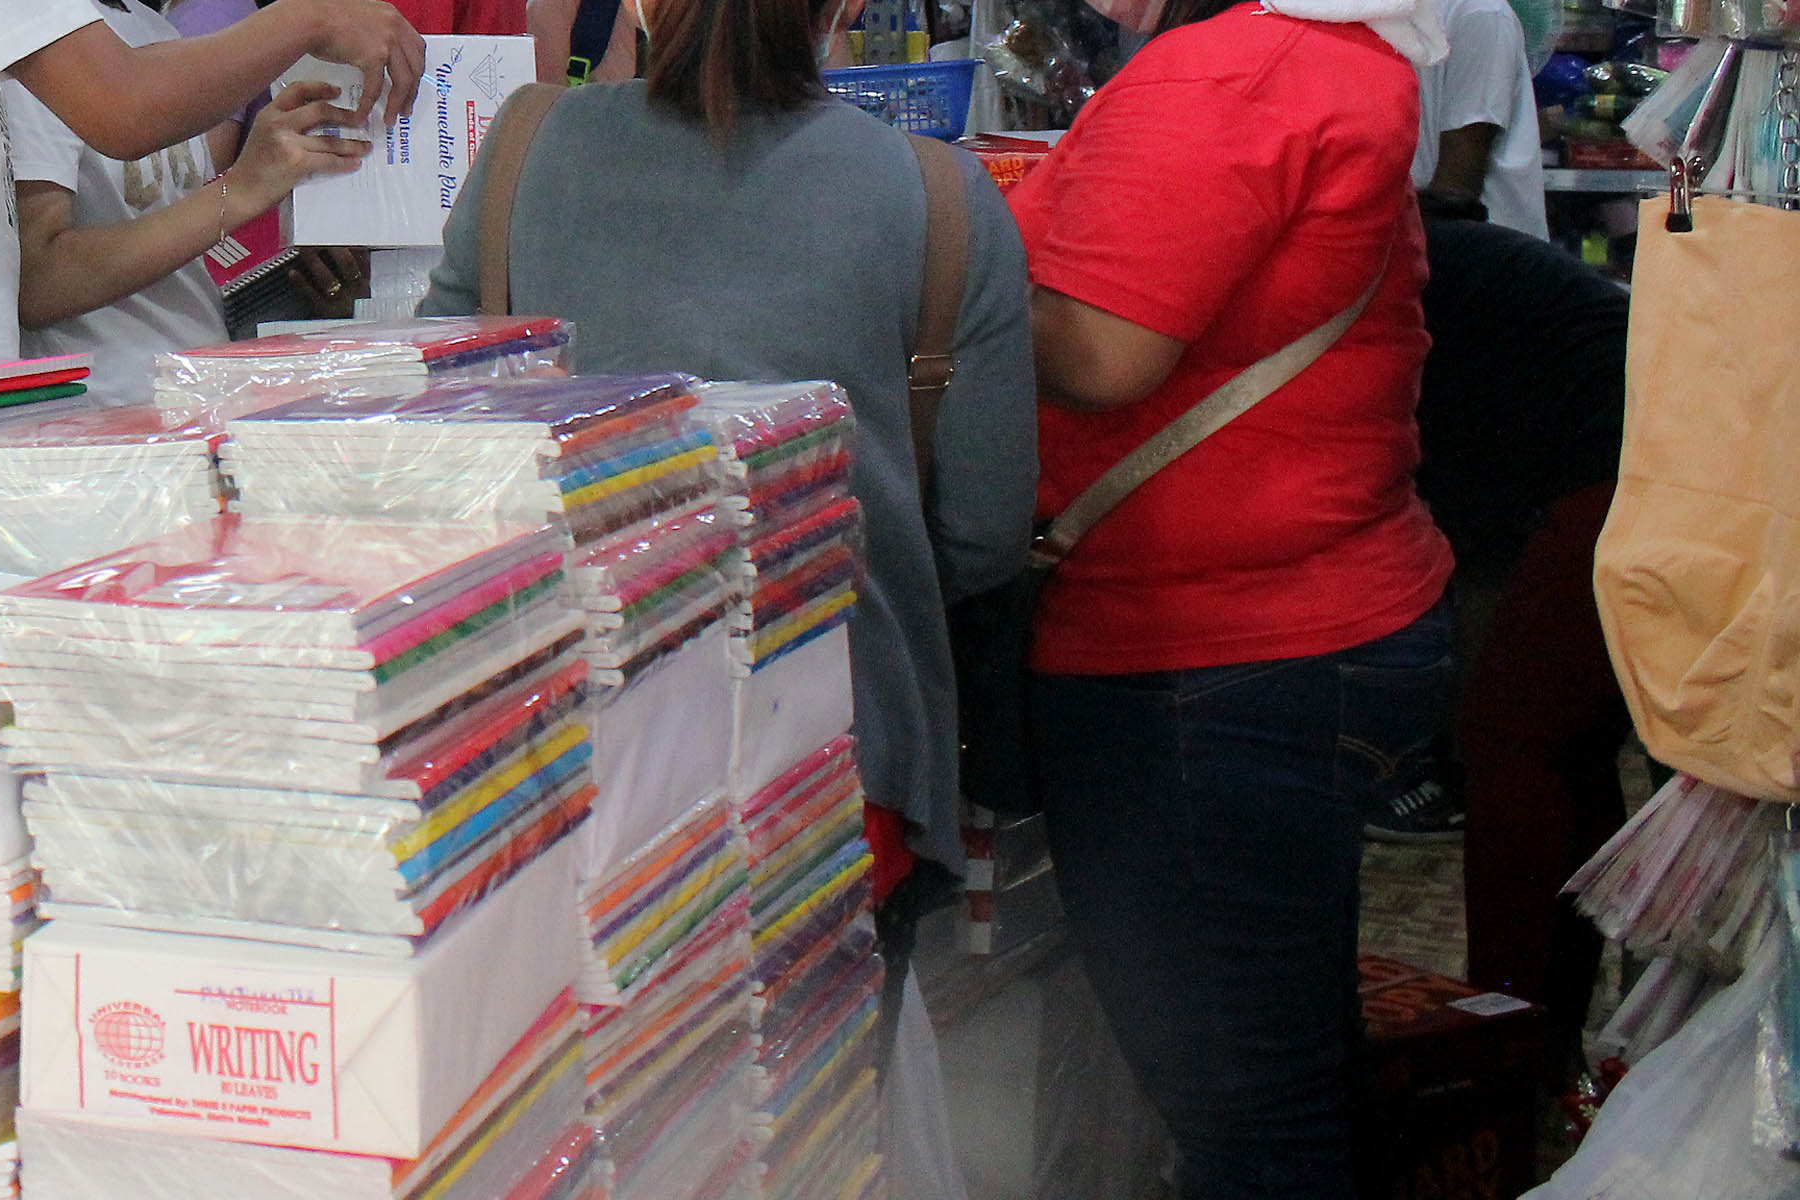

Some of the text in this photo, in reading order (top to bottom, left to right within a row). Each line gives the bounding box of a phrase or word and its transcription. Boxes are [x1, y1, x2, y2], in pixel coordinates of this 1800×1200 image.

[399, 127, 411, 164] Leaves
[435, 63, 458, 209] Intermediate Pad
[87, 999, 167, 1026] UNIVERSAL
[225, 1000, 288, 1015] NOTEBOOK
[186, 1021, 321, 1086] WRITING
[234, 1082, 279, 1100] LEAVES
